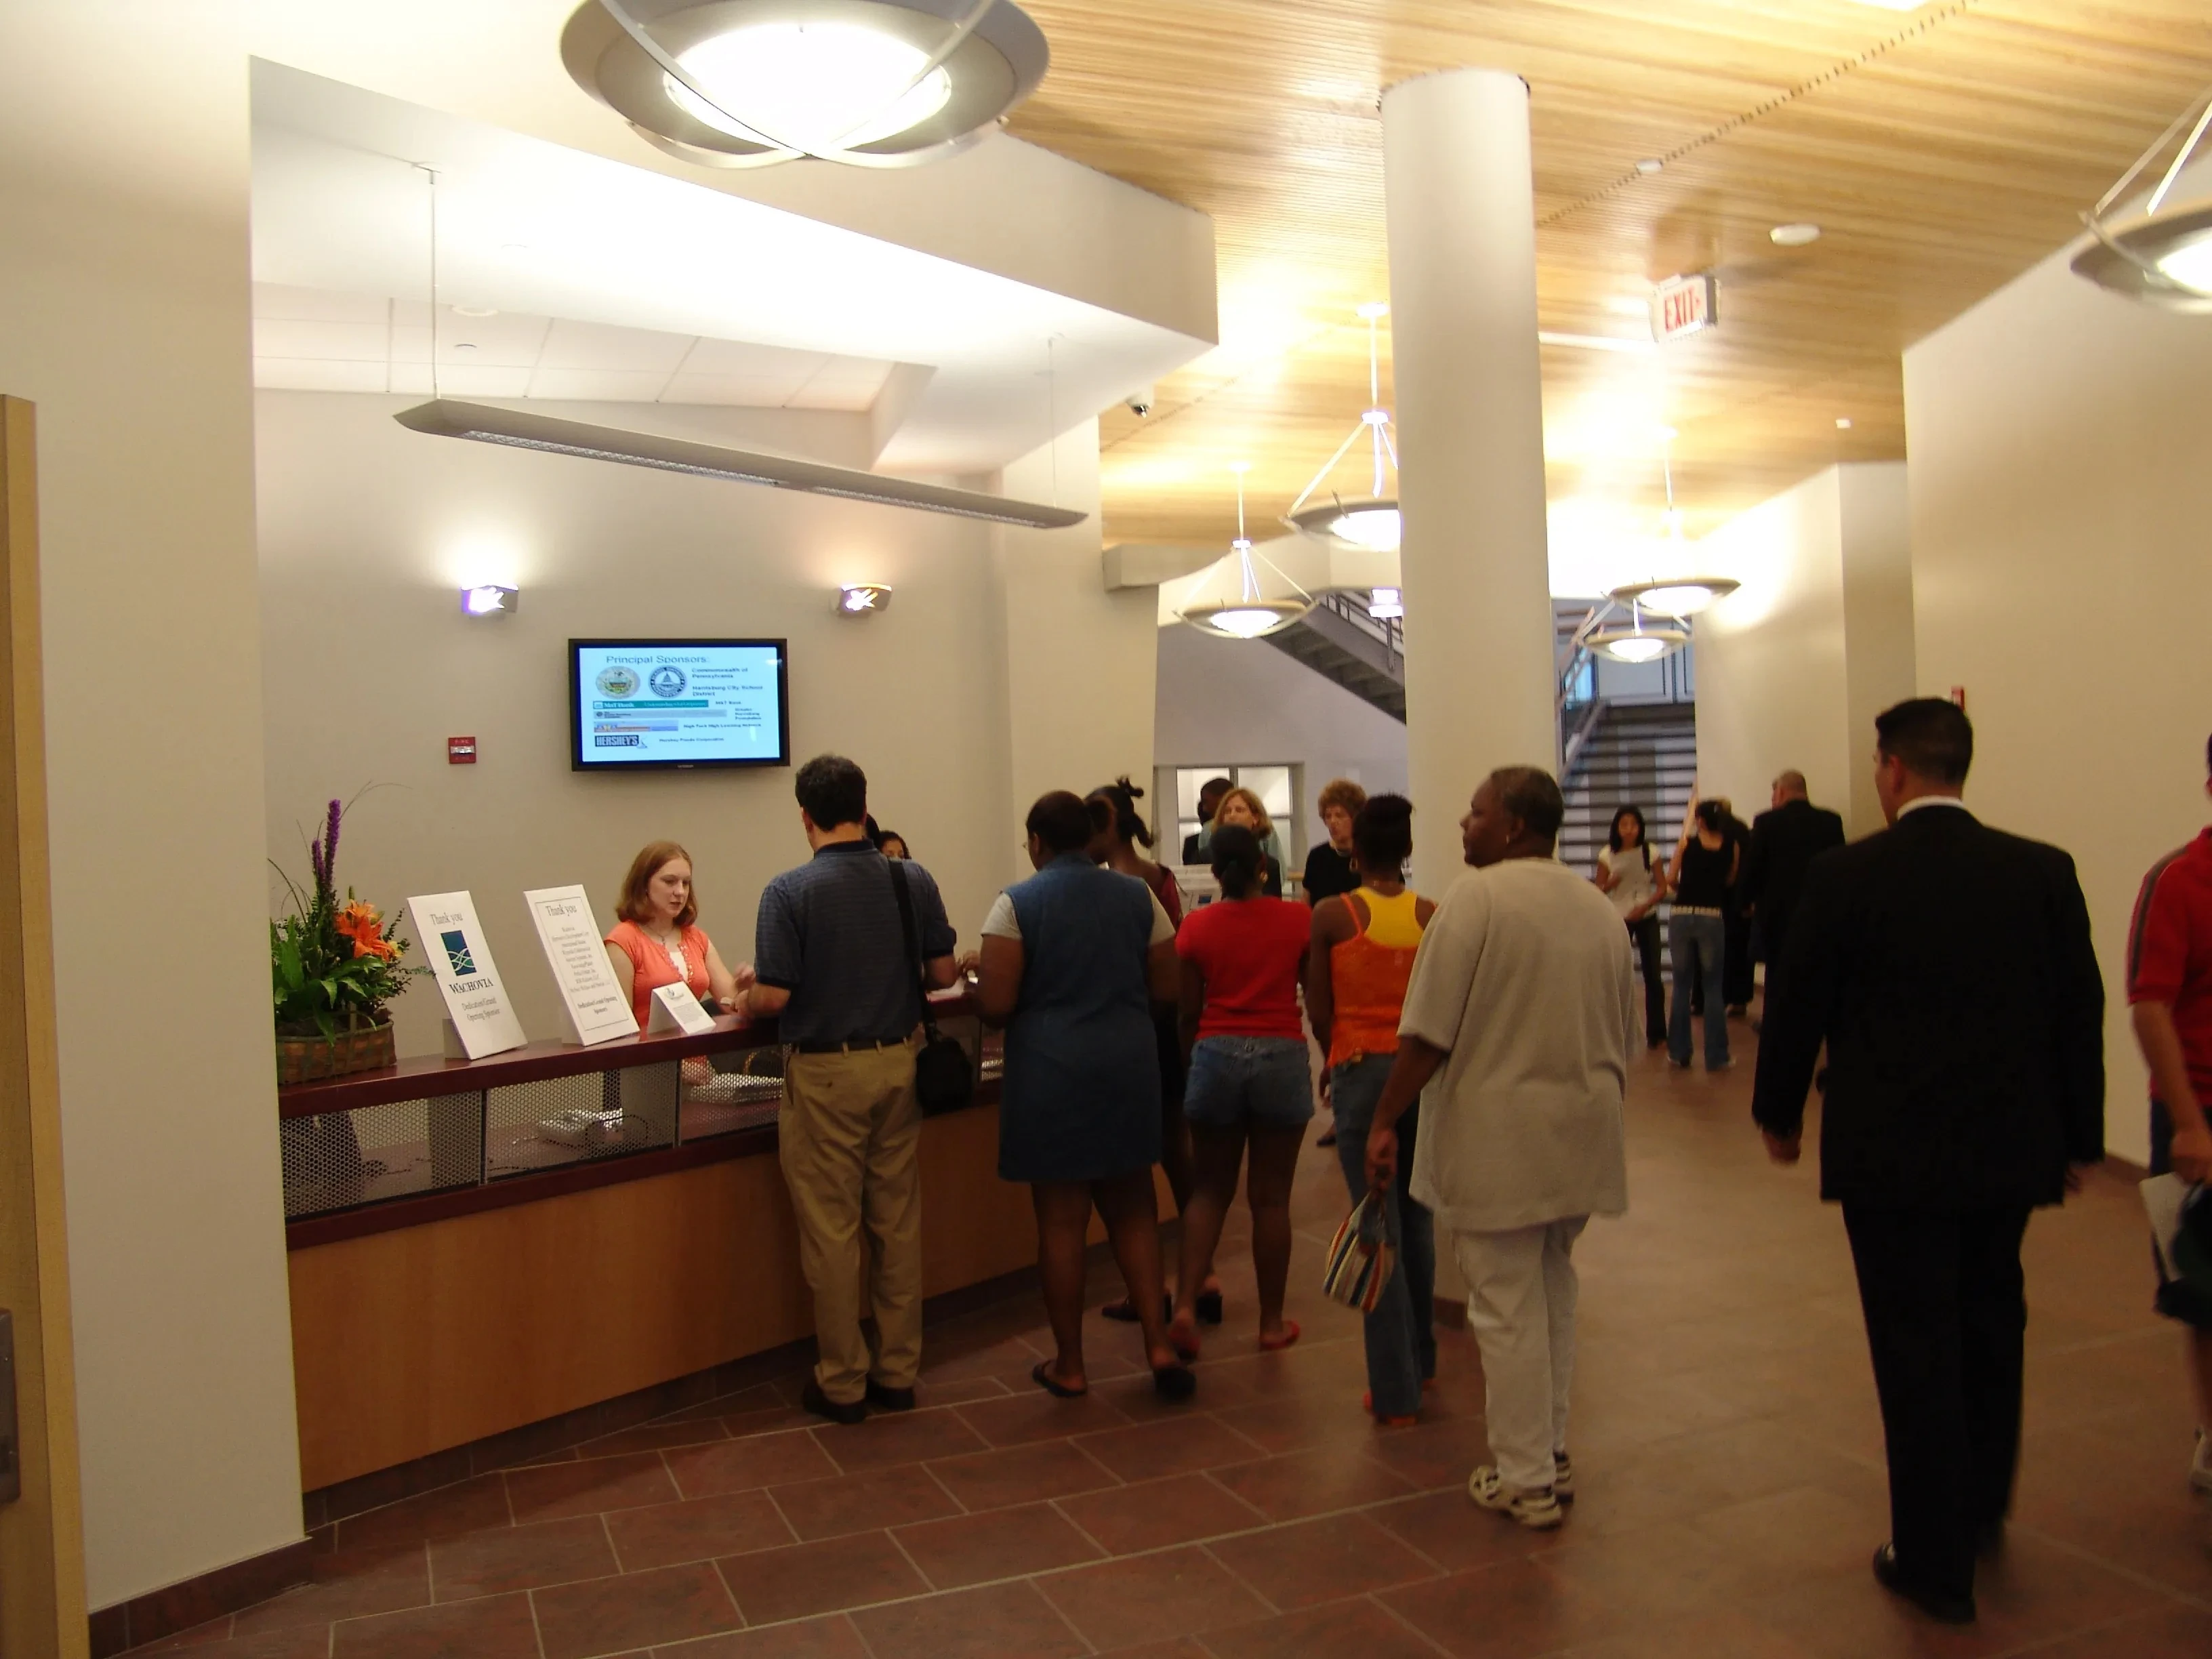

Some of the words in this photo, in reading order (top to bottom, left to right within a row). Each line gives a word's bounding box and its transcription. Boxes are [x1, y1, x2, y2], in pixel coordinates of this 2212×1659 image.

[1664, 285, 1694, 333] EXIT
[606, 655, 653, 665] Principal
[596, 735, 638, 746] HERSHEY'S
[545, 903, 565, 916] Thank
[565, 905, 577, 917] you
[430, 912, 450, 925] Thank
[450, 912, 464, 925] you
[449, 977, 494, 995] WACHOVIA
